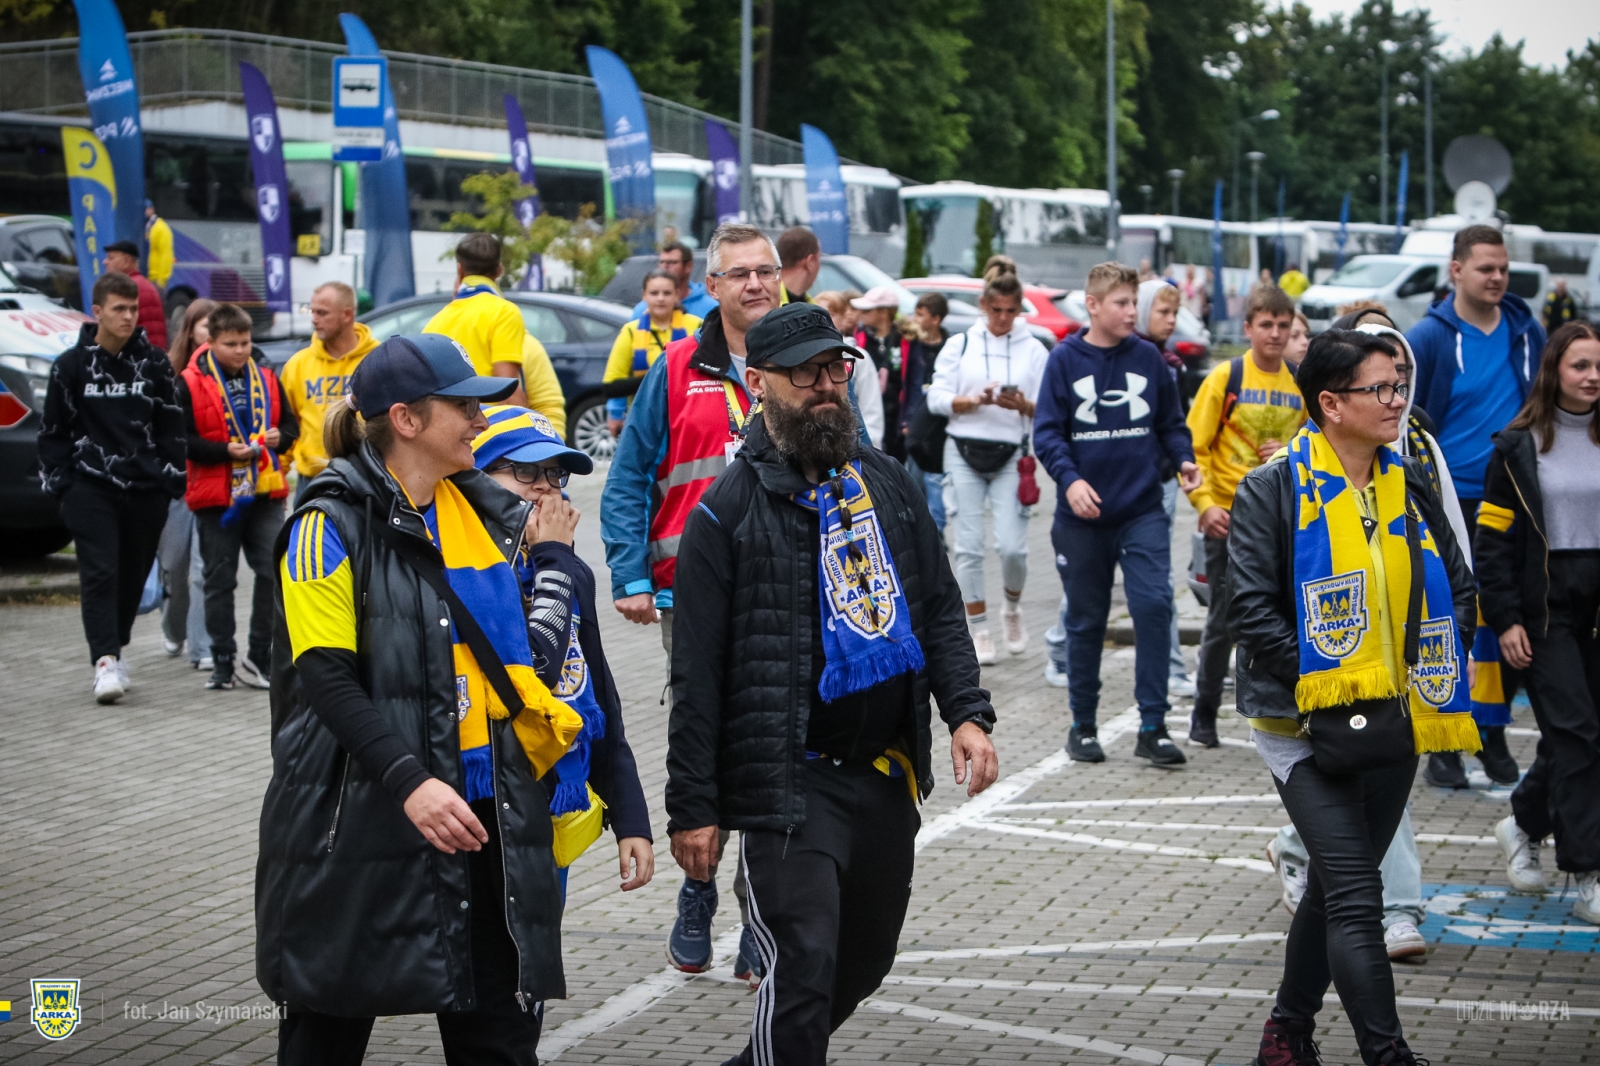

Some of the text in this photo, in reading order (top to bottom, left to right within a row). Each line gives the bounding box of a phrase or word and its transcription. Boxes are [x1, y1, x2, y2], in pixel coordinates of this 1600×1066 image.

[1071, 430, 1110, 441] UNDER
[846, 579, 884, 604] ARA
[1318, 618, 1355, 632] ARKA
[1420, 666, 1449, 677] ARKA
